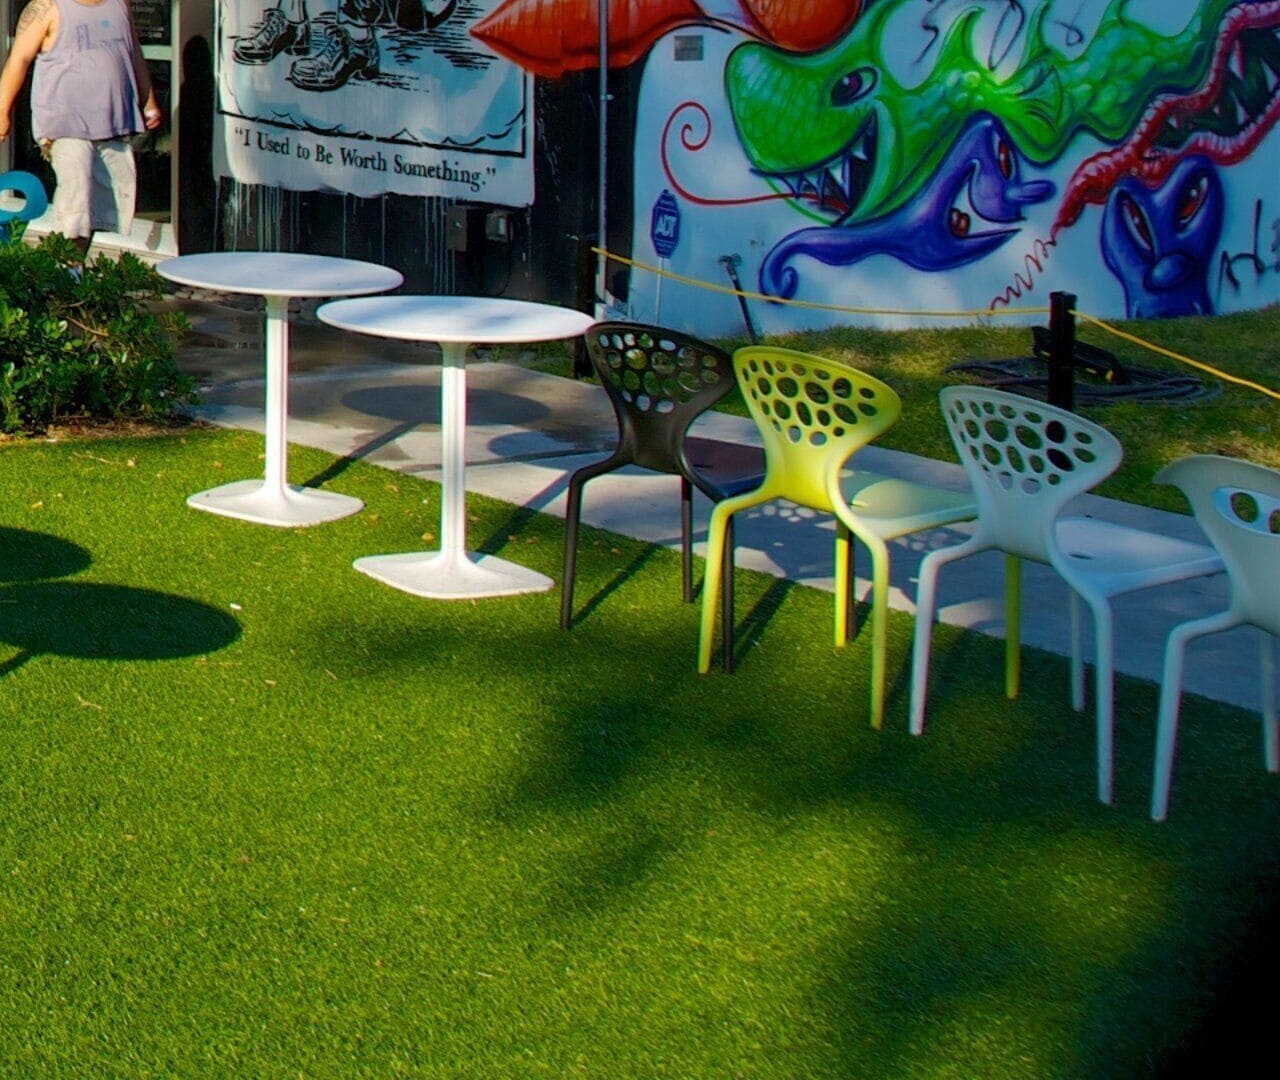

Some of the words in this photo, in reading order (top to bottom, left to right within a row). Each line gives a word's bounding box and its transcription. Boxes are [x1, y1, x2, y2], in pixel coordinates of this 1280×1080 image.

[257, 128, 290, 156] Used
[296, 145, 310, 159] to
[316, 146, 333, 165] Be
[340, 147, 387, 172] Worth
[654, 215, 677, 237] ADT
